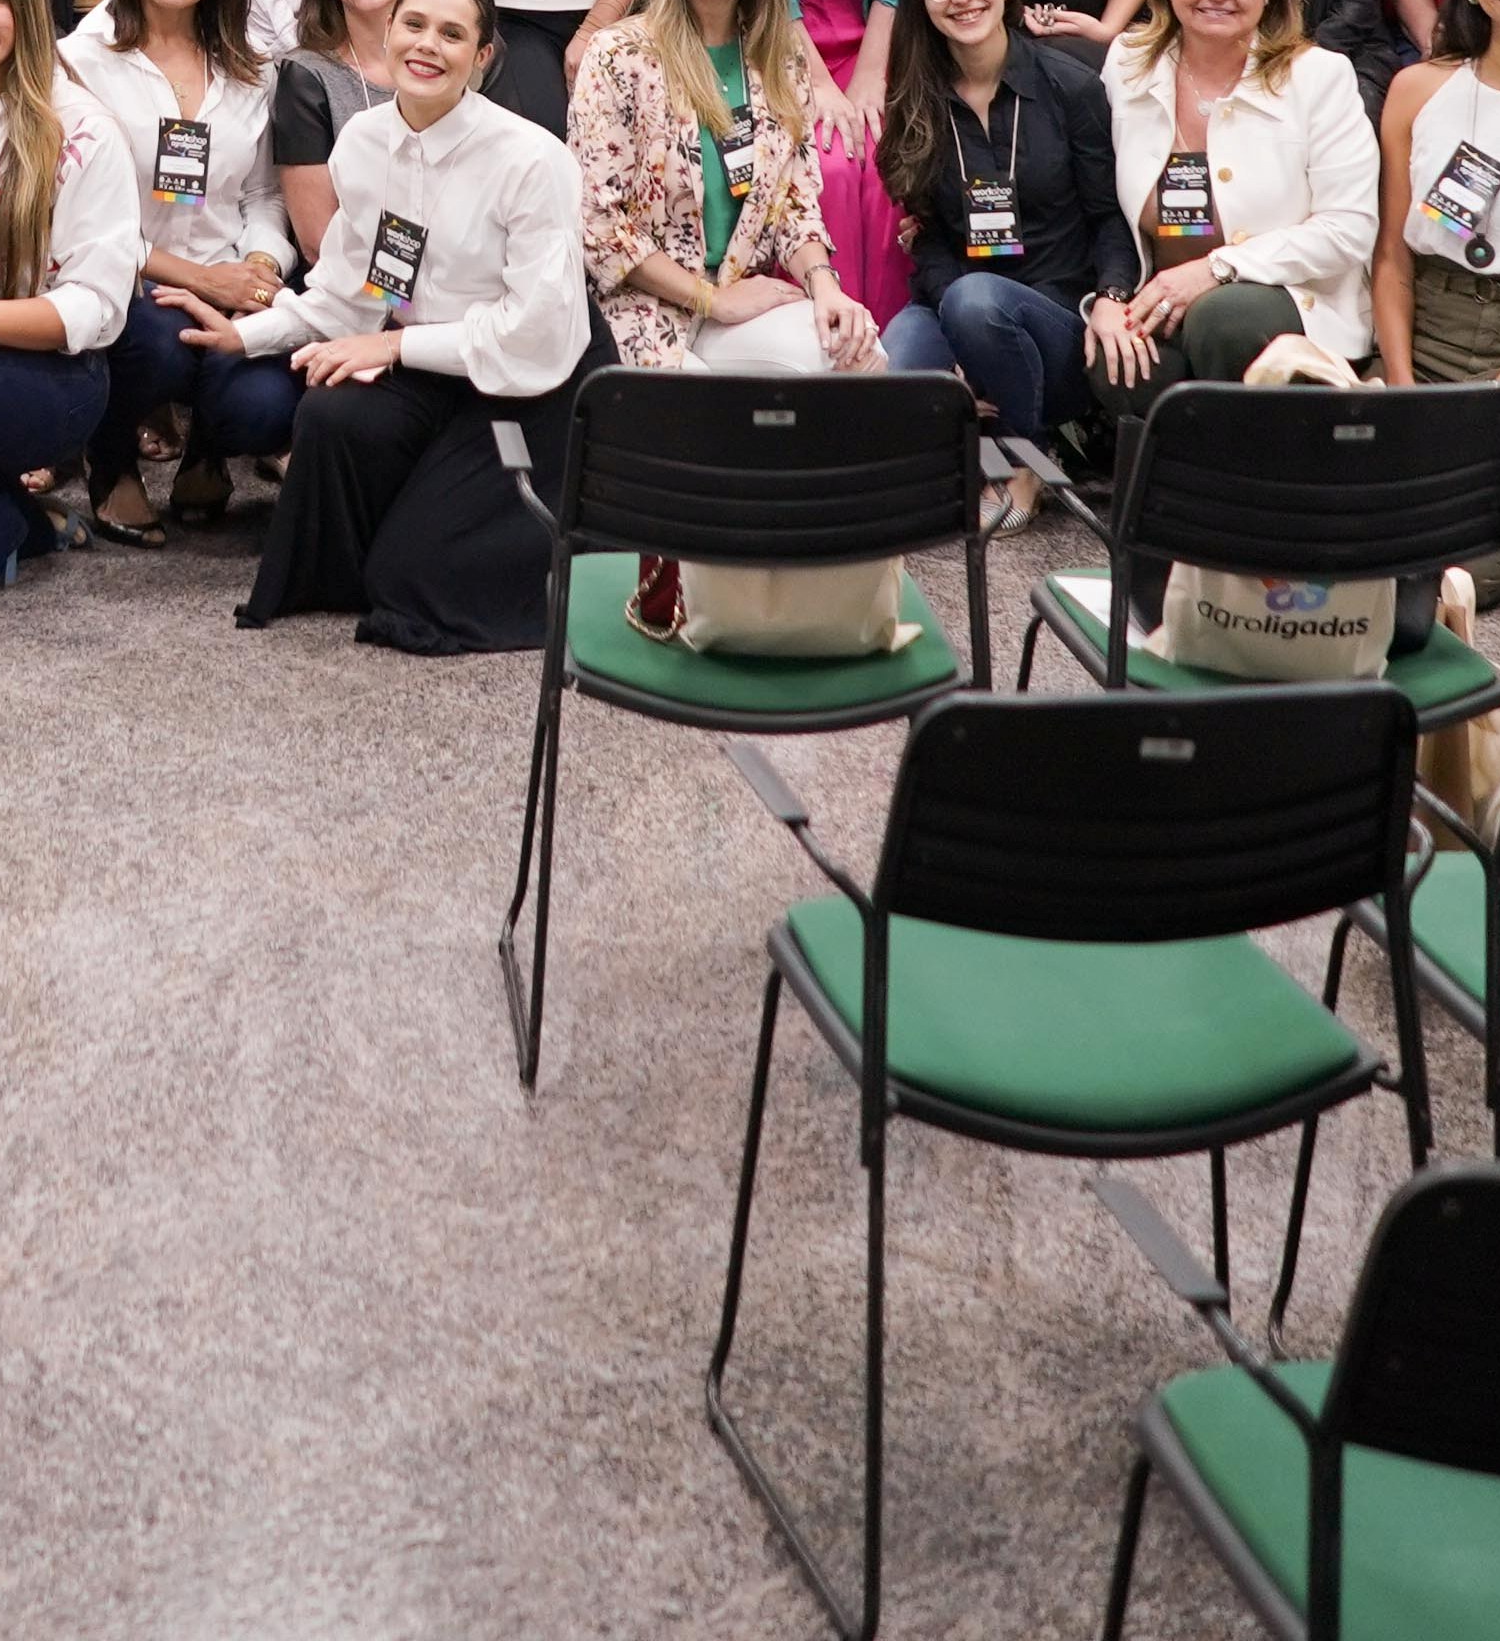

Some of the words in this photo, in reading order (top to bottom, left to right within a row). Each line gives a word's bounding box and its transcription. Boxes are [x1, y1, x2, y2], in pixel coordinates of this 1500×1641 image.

[168, 132, 207, 145] workshop
[1167, 166, 1207, 175] workshop
[970, 187, 1012, 197] workshop
[386, 228, 420, 250] workshop
[1197, 600, 1370, 640] agroligadas
